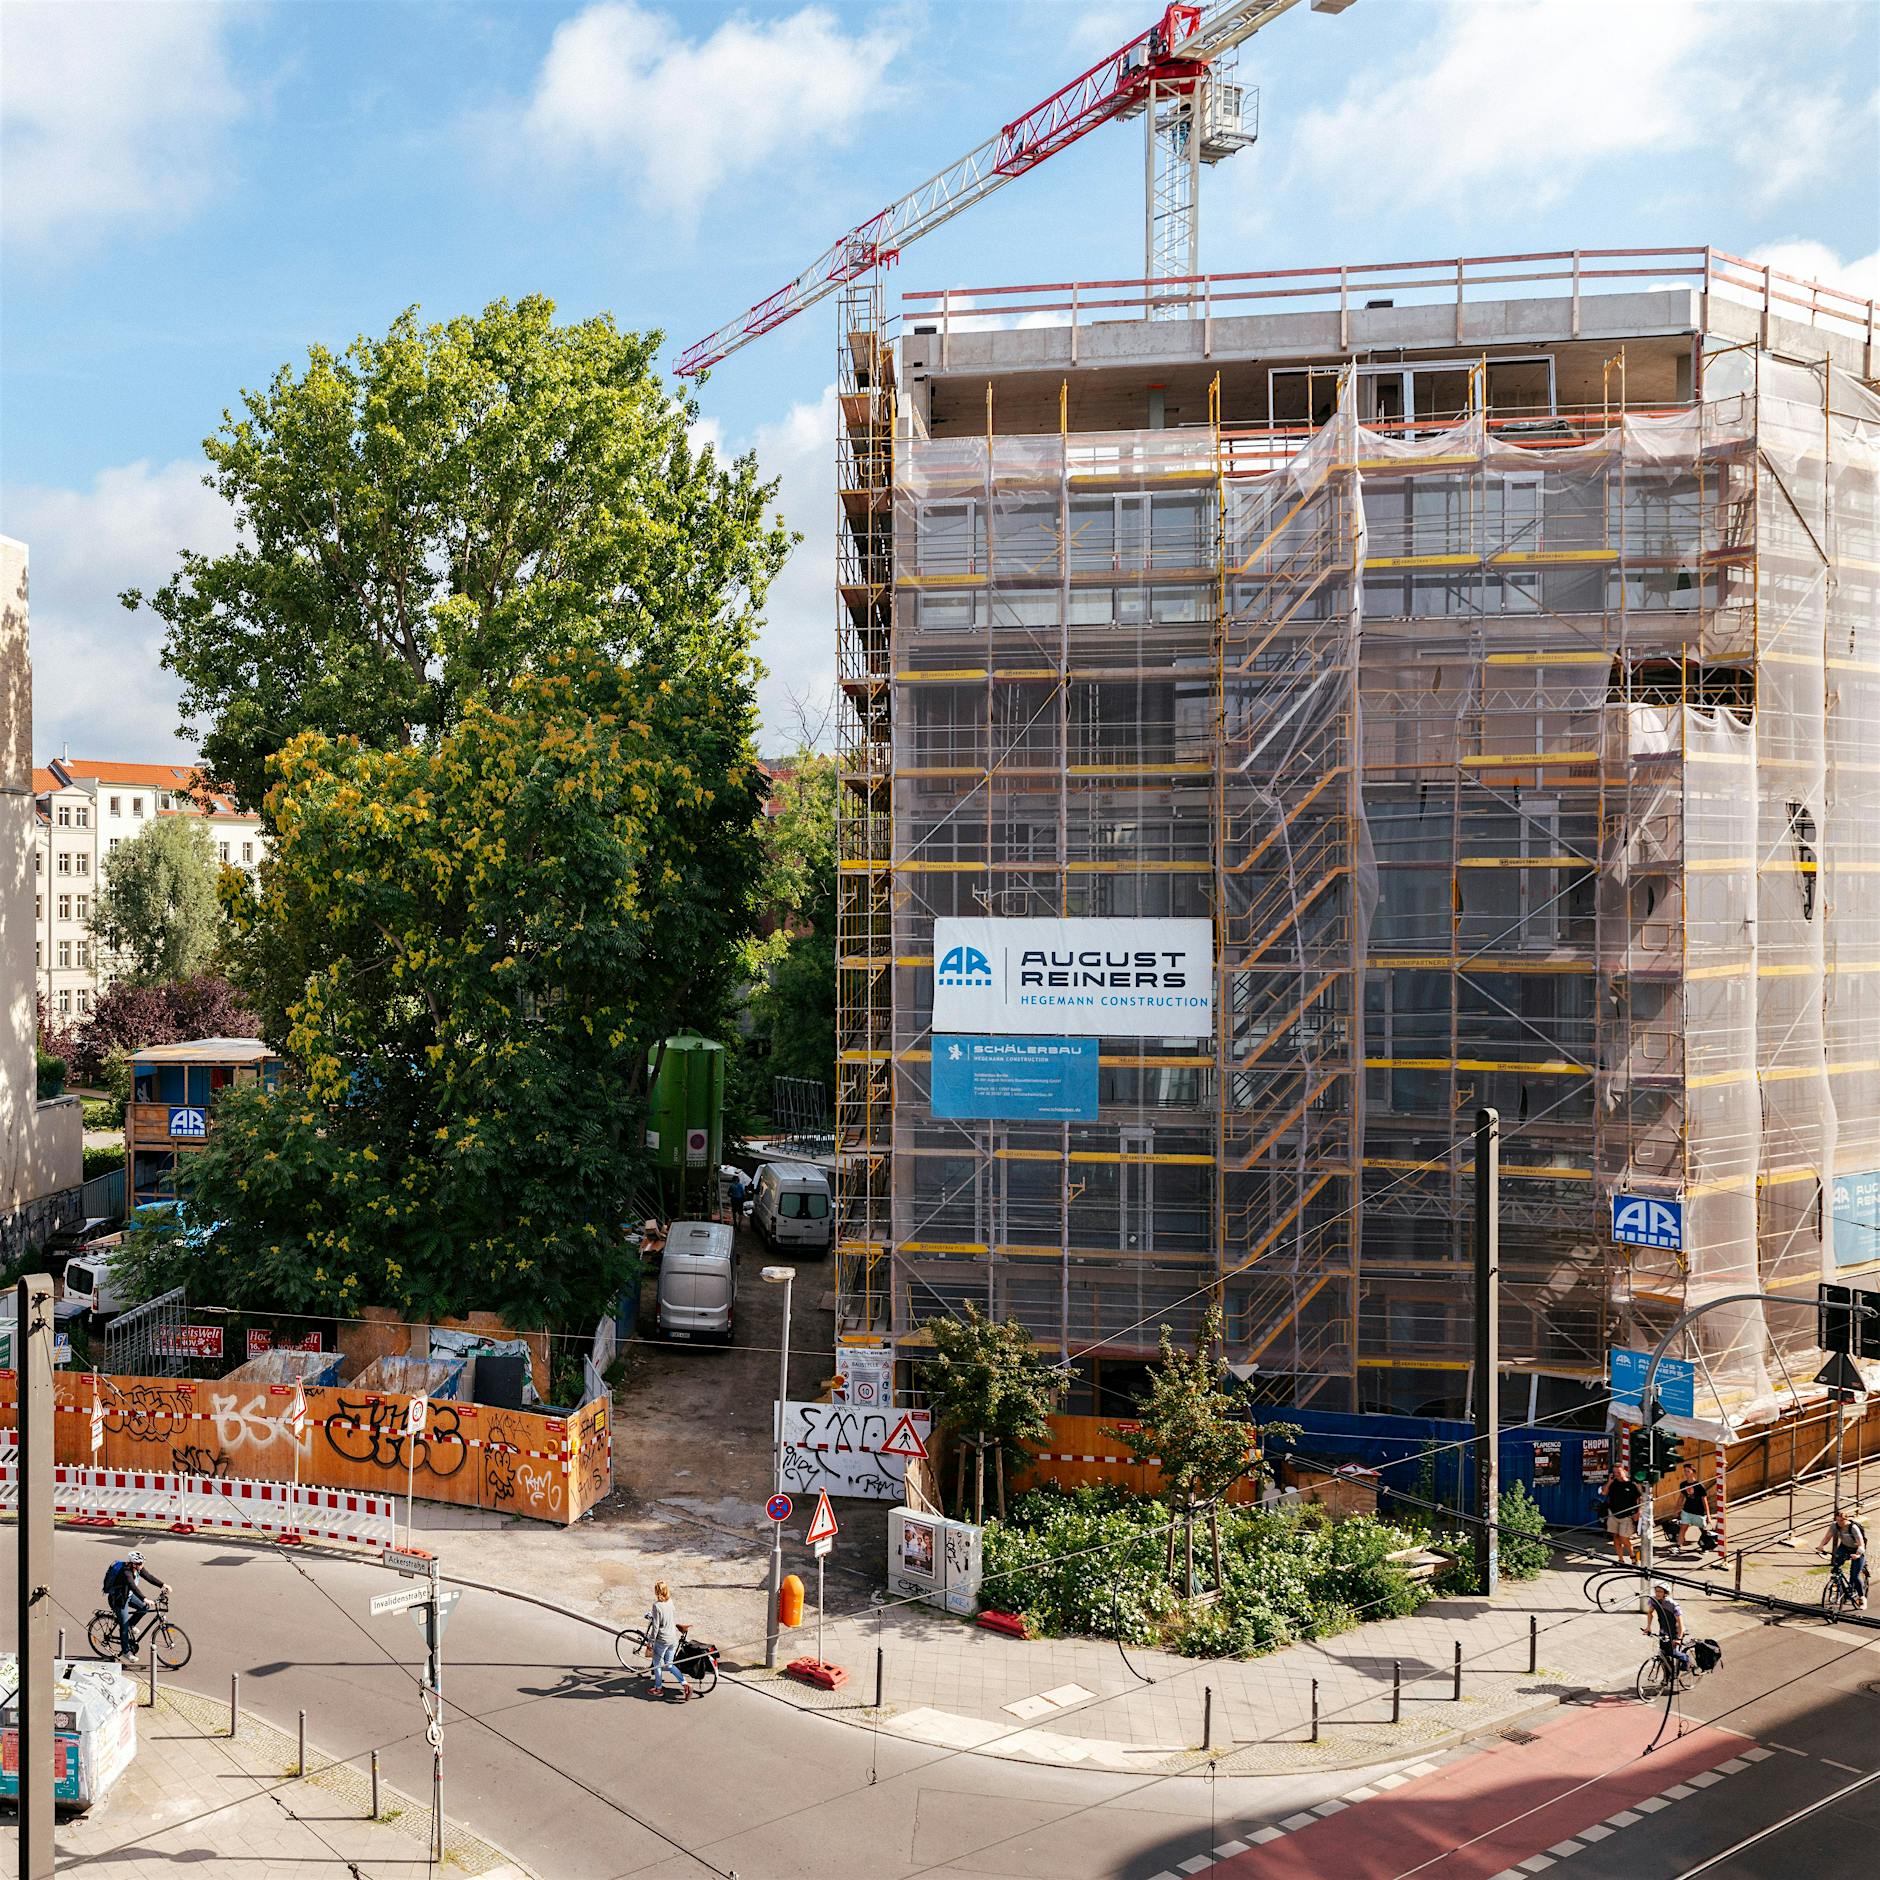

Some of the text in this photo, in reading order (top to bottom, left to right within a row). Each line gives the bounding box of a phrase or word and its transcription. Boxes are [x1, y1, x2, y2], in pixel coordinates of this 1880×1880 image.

[1021, 951, 1186, 968] AUGUST
[1021, 971, 1186, 988] REINERS
[1020, 995, 1208, 1008] HEGEMANN CONSTRUCTION
[973, 1044, 1082, 1055] SCHÄLERBAU
[1615, 1200, 1680, 1237] AR
[1583, 1439, 1609, 1449] CHOPIN
[388, 1555, 426, 1571] Ackerstraße
[373, 1588, 428, 1609] Invalidenstraße
